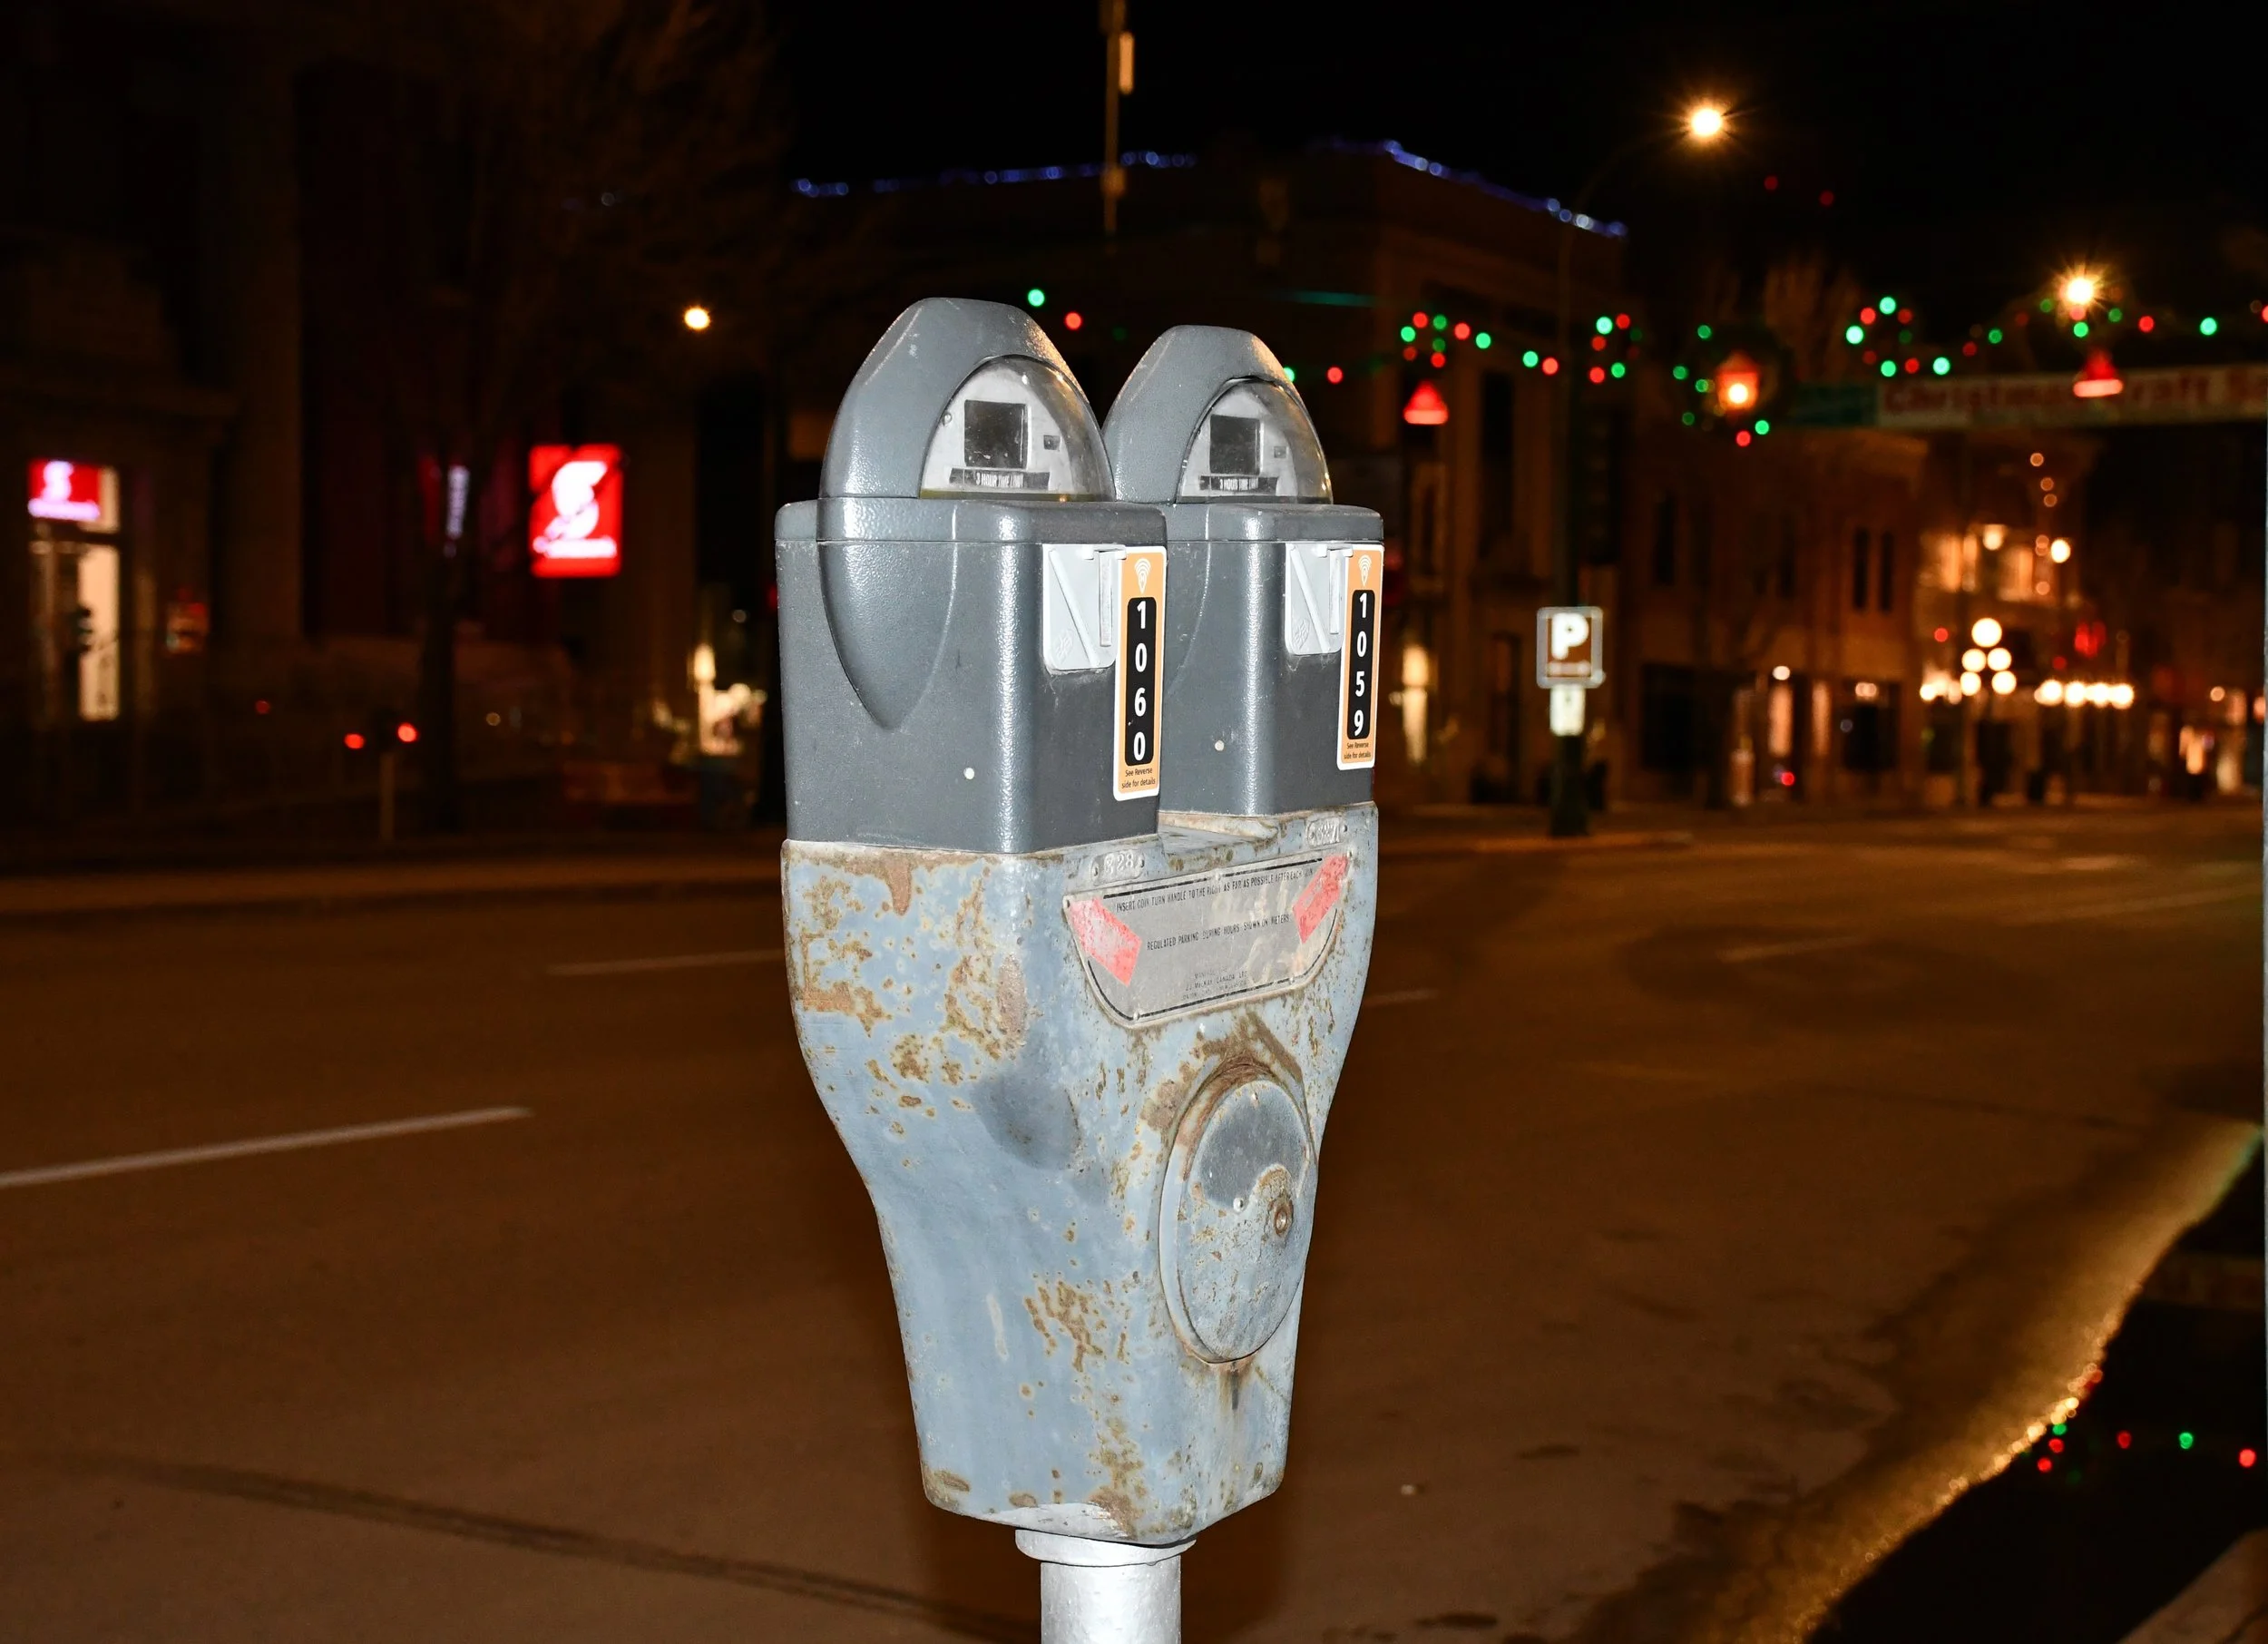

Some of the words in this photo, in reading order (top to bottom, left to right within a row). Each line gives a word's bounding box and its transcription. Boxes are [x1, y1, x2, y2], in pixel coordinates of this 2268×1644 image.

[981, 473, 997, 487] HOUR
[1551, 612, 1589, 660] P
[1354, 592, 1367, 737] 1059
[1133, 600, 1148, 761] 1060
[1121, 780, 1131, 789] side
[1139, 777, 1156, 787] details
[1135, 768, 1153, 776] Reverse
[1116, 901, 1135, 912] INSERT
[1151, 895, 1166, 905] TURN
[1168, 891, 1186, 903] HANDLE
[1188, 890, 1195, 899] TO
[1197, 887, 1205, 896] THE
[1223, 883, 1230, 892] AS
[1243, 878, 1249, 887] AS
[1147, 936, 1176, 951] REGULATED
[1178, 932, 1198, 944] PARKING
